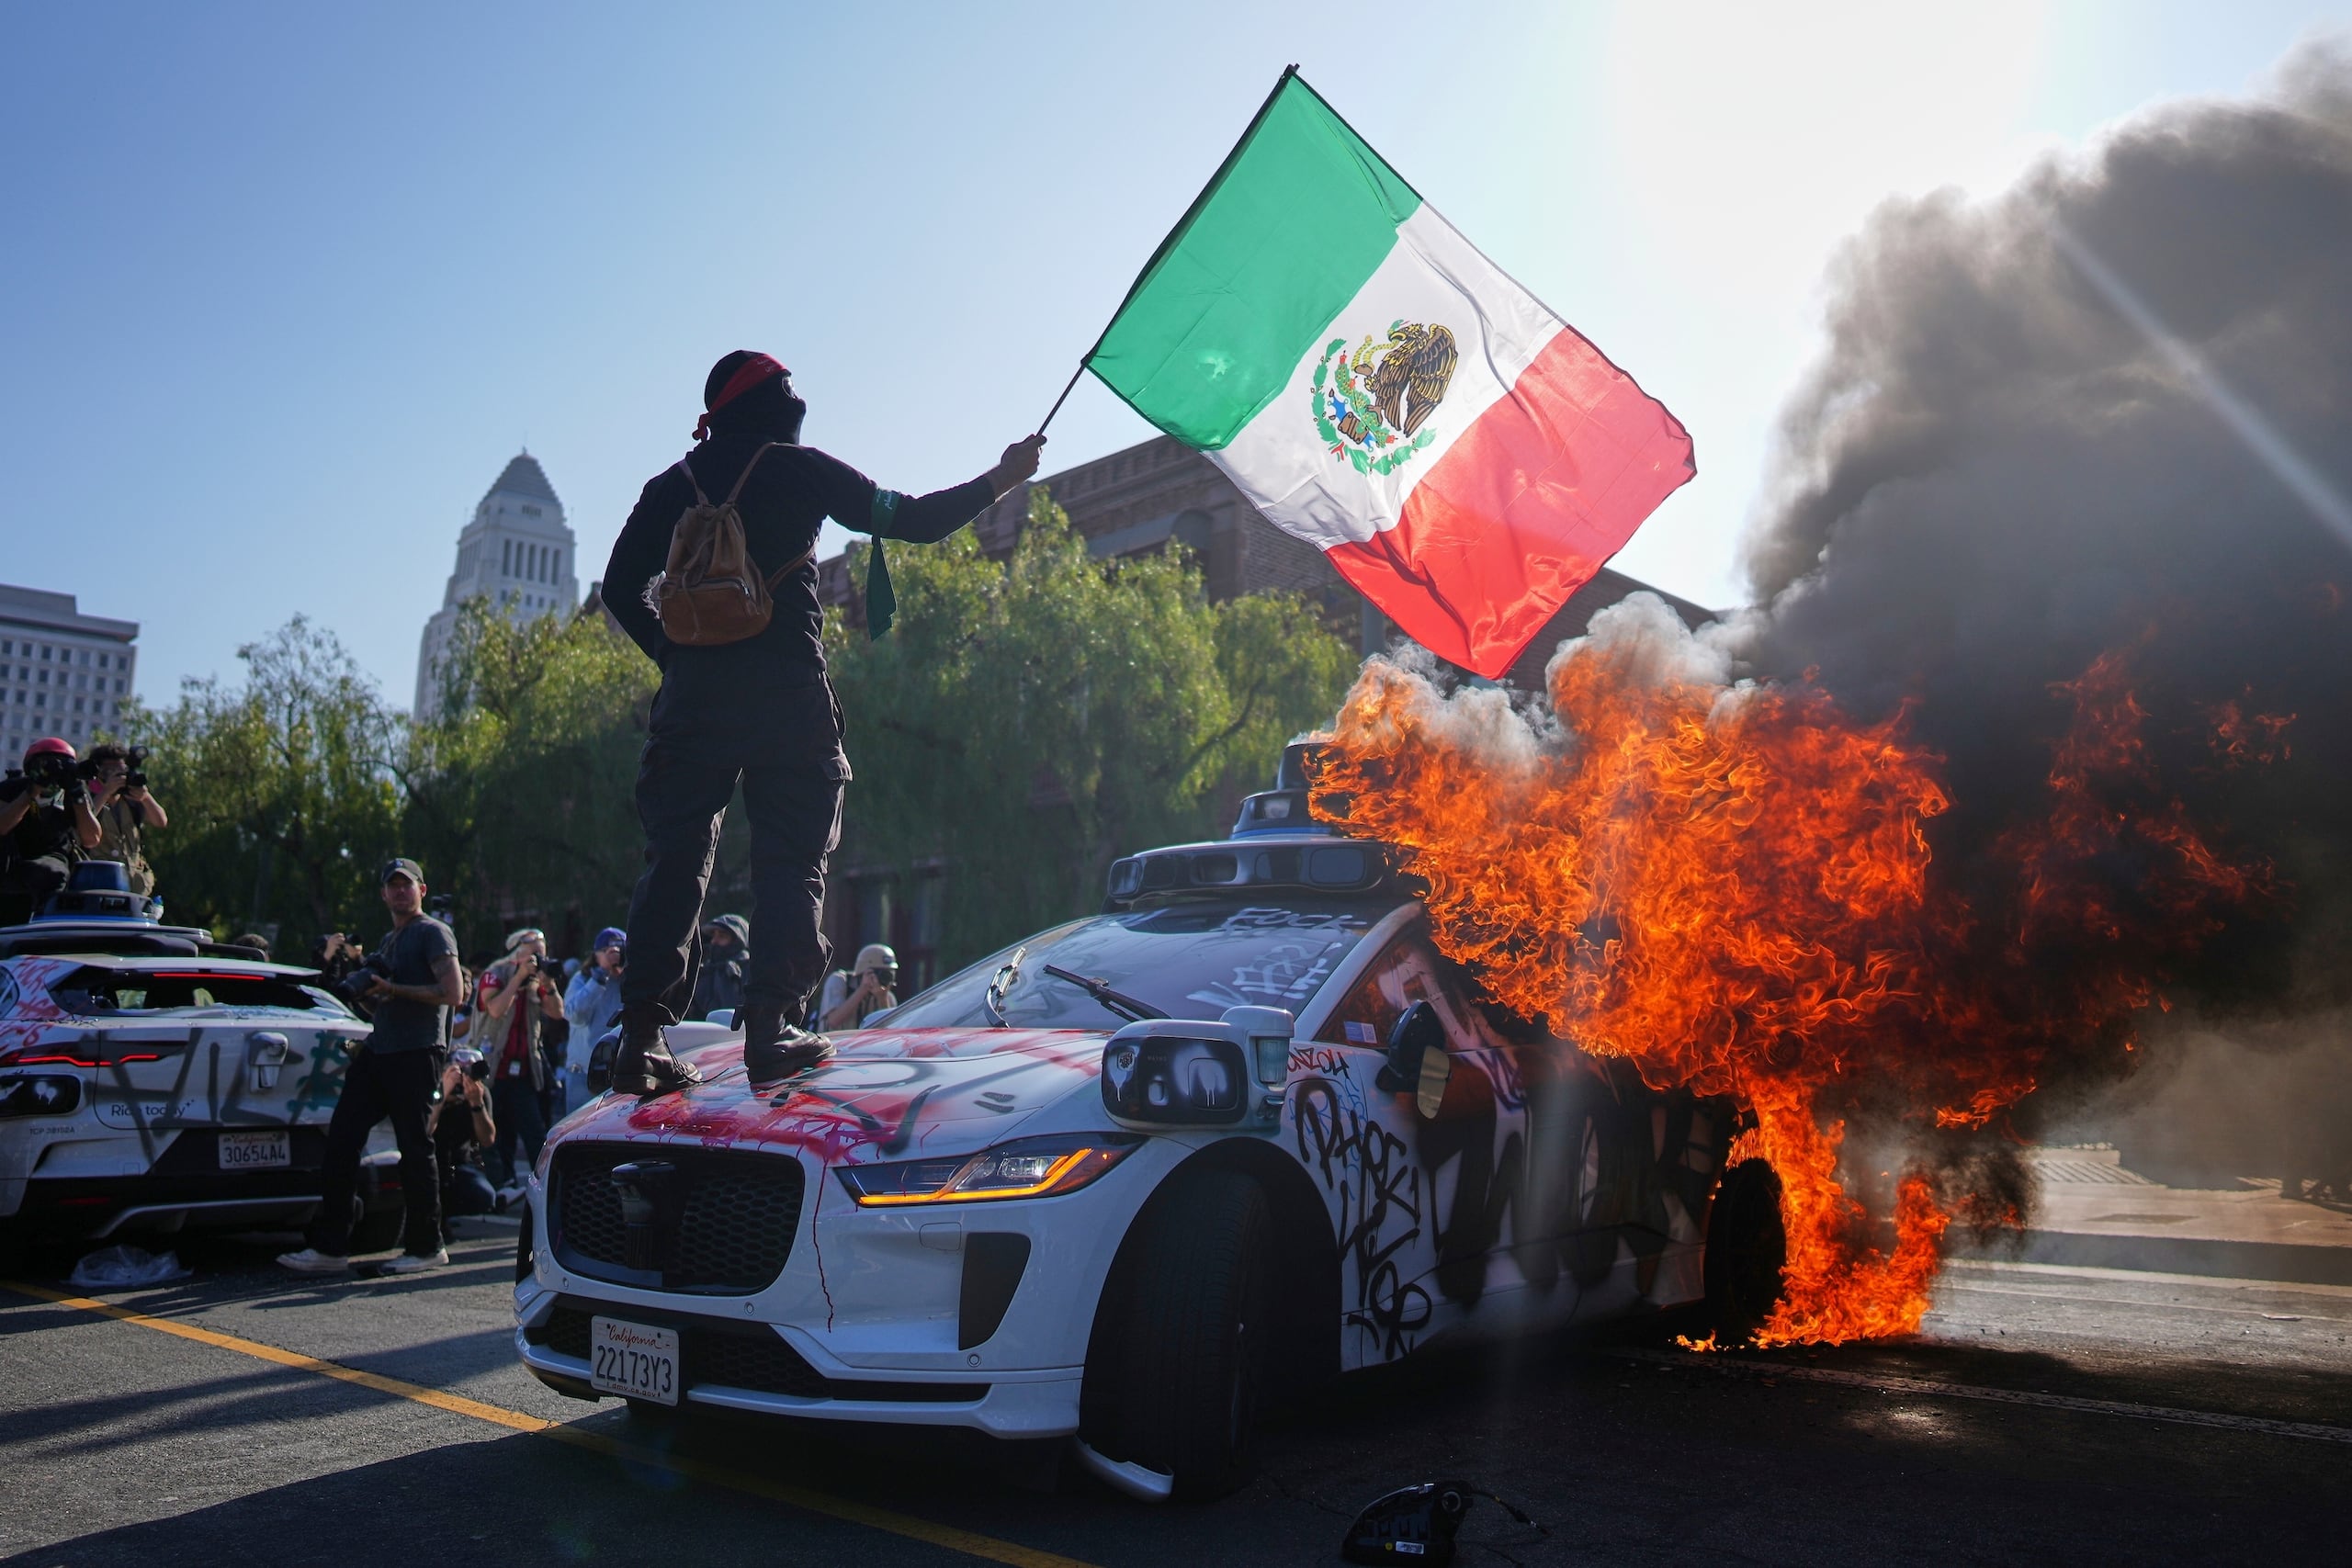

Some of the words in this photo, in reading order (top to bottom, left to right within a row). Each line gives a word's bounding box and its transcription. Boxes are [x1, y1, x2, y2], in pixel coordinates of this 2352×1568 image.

[484, 974, 496, 985] 12
[224, 1145, 286, 1163] 30654A4
[608, 1324, 662, 1348] California
[596, 1345, 672, 1393] 22173Y3
[612, 1382, 656, 1397] dmv.ca.gov
